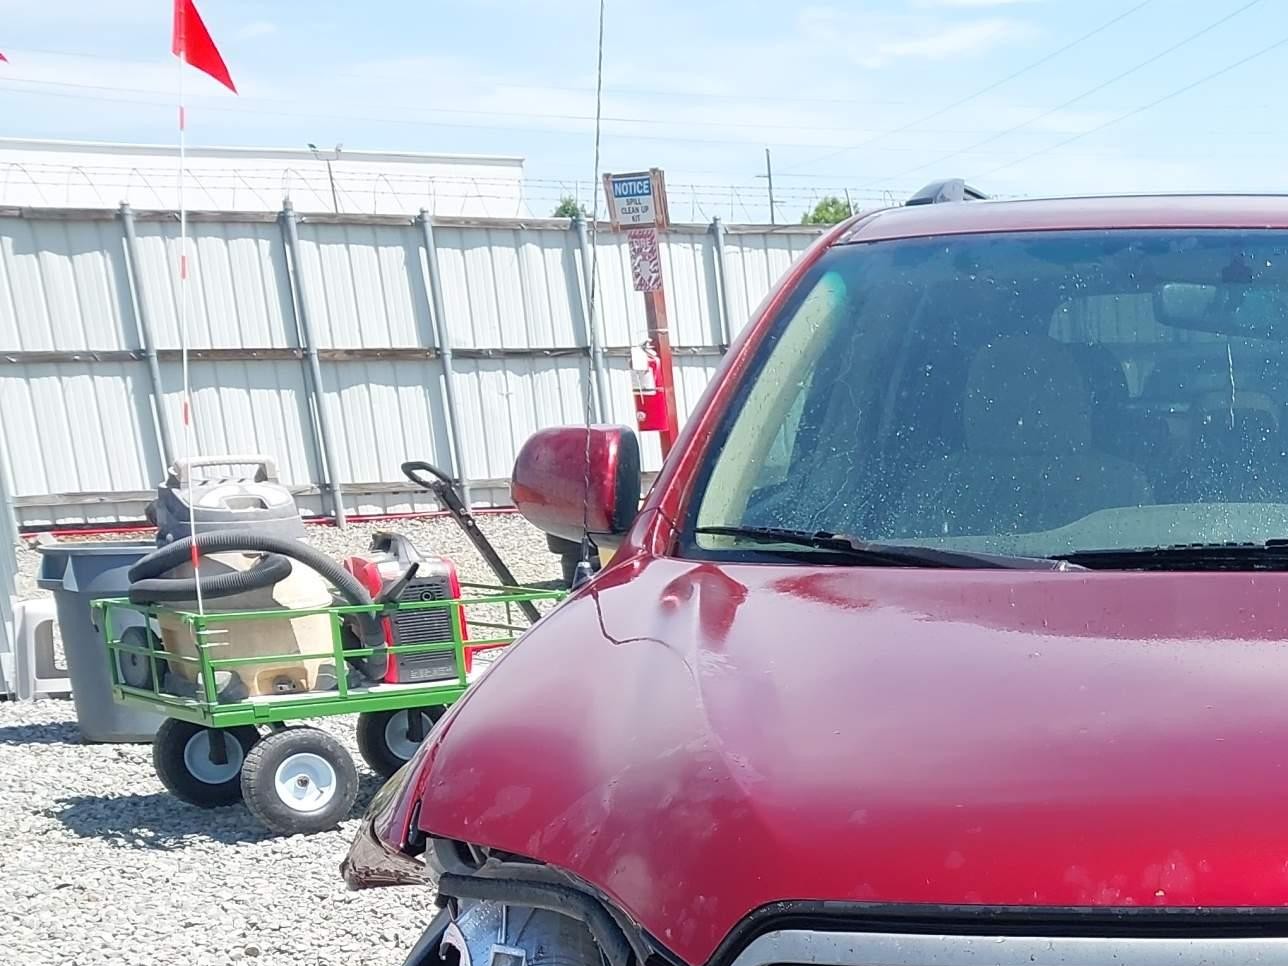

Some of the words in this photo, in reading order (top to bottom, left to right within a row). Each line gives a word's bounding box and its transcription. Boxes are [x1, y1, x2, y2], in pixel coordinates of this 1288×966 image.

[614, 180, 650, 196] NOTICE
[625, 198, 642, 206] SPILL
[640, 205, 649, 214] UP
[631, 214, 641, 222] KIT
